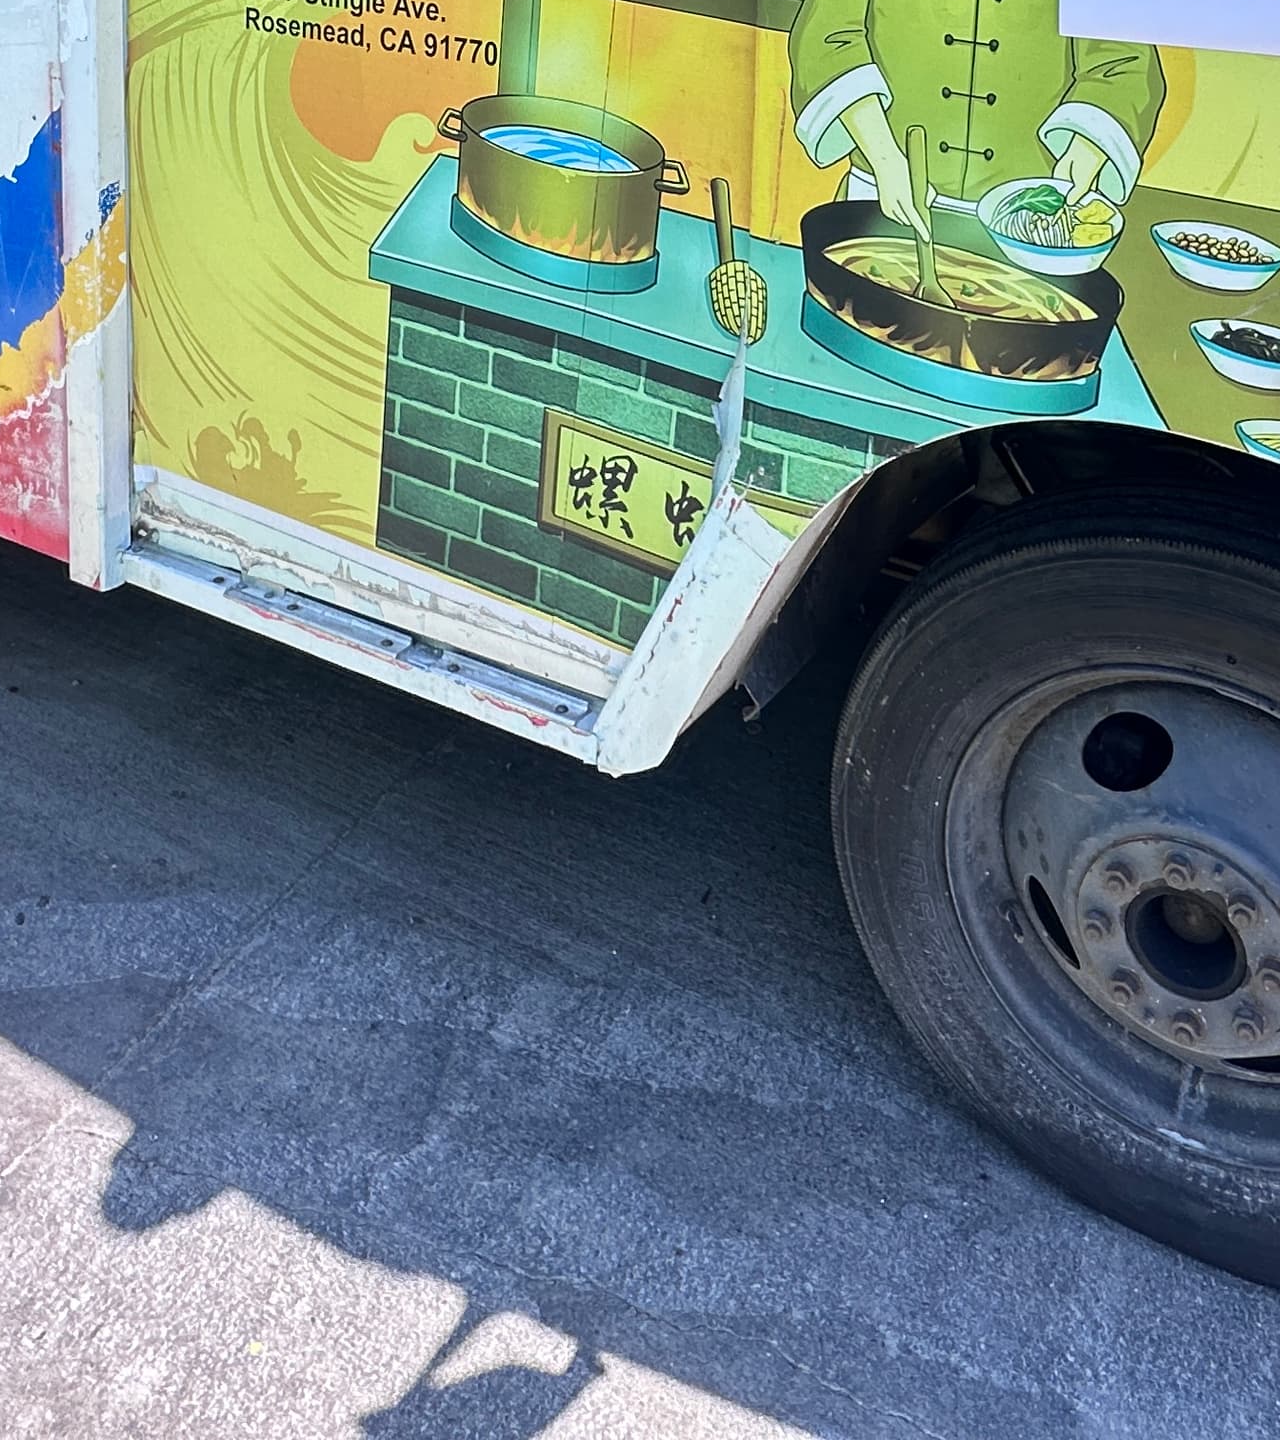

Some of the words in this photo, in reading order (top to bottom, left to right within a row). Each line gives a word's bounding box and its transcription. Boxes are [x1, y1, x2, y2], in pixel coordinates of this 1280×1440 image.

[245, 7, 372, 53] Rosemead,
[379, 26, 417, 54] CA
[423, 32, 498, 67] 91770
